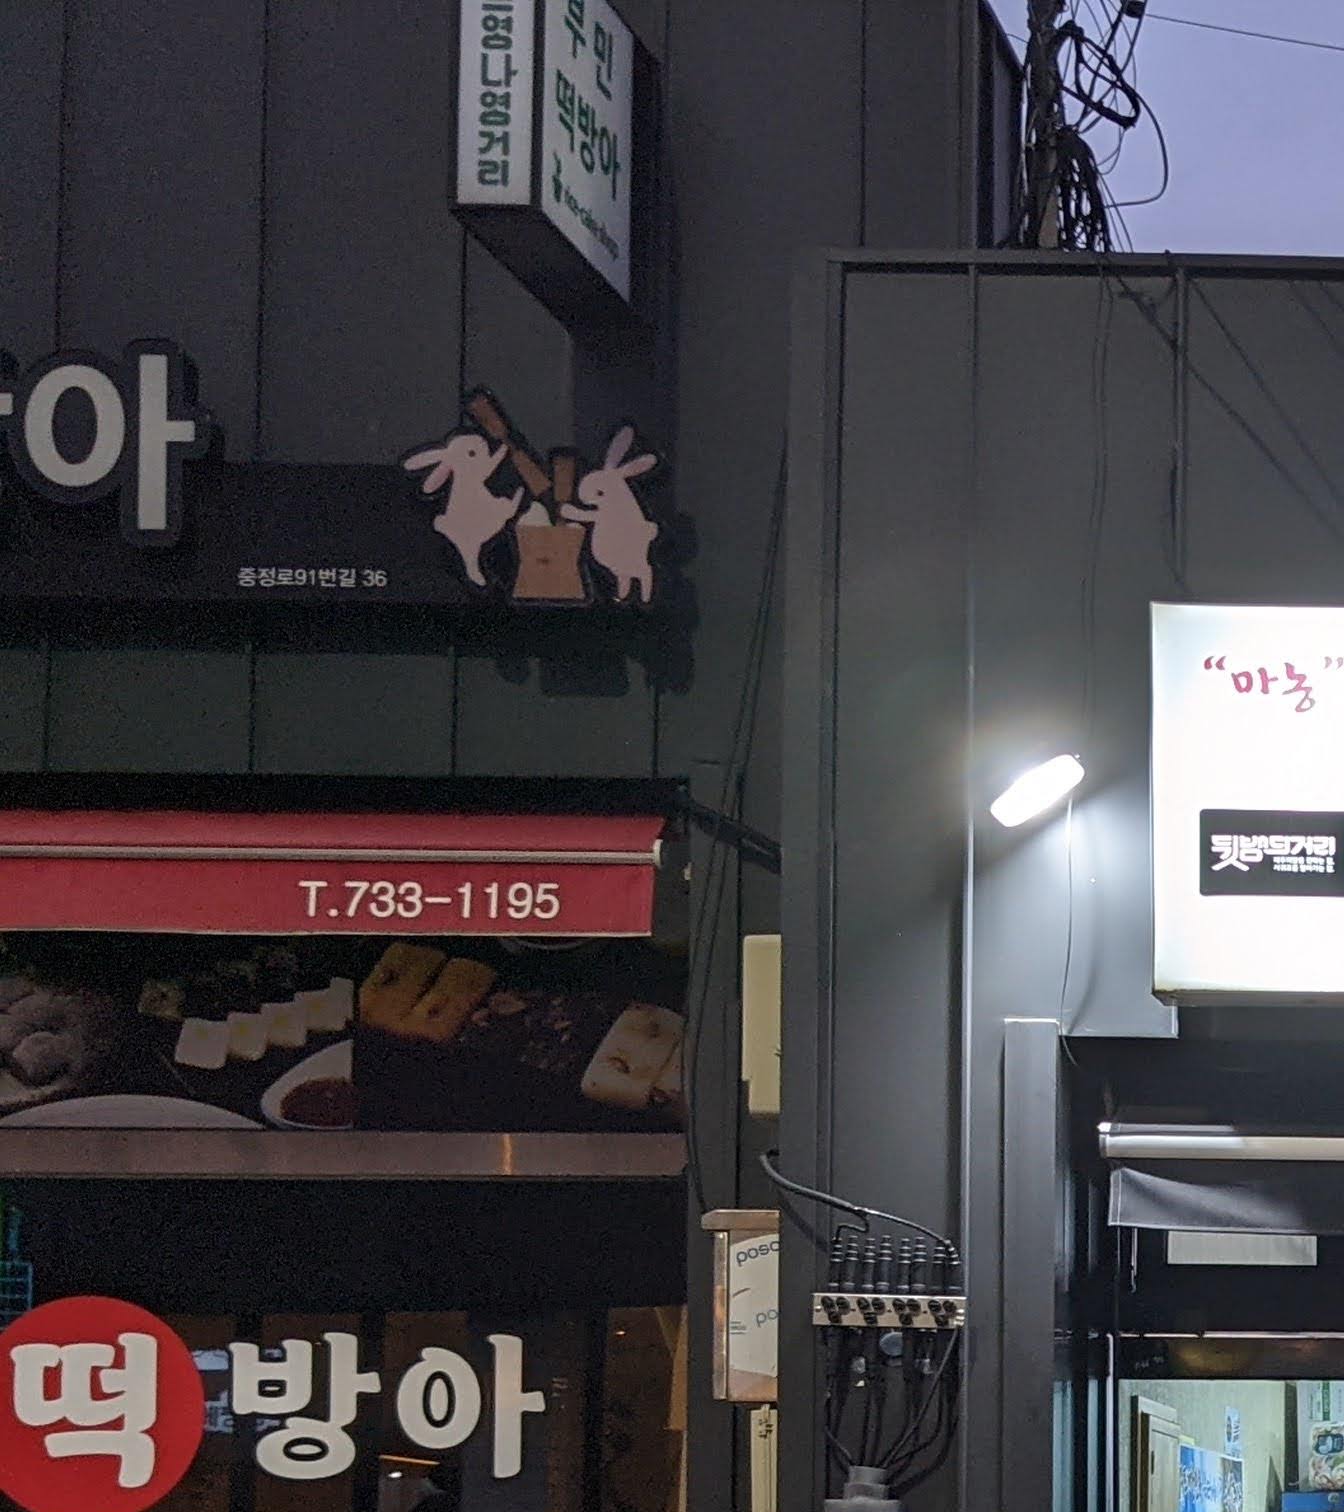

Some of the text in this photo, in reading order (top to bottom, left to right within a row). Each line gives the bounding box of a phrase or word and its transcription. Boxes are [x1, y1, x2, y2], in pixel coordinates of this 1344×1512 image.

[555, 68, 621, 201] 떡방아
[237, 564, 388, 589] 중정로91번길 36
[298, 880, 561, 919] T.733-1195
